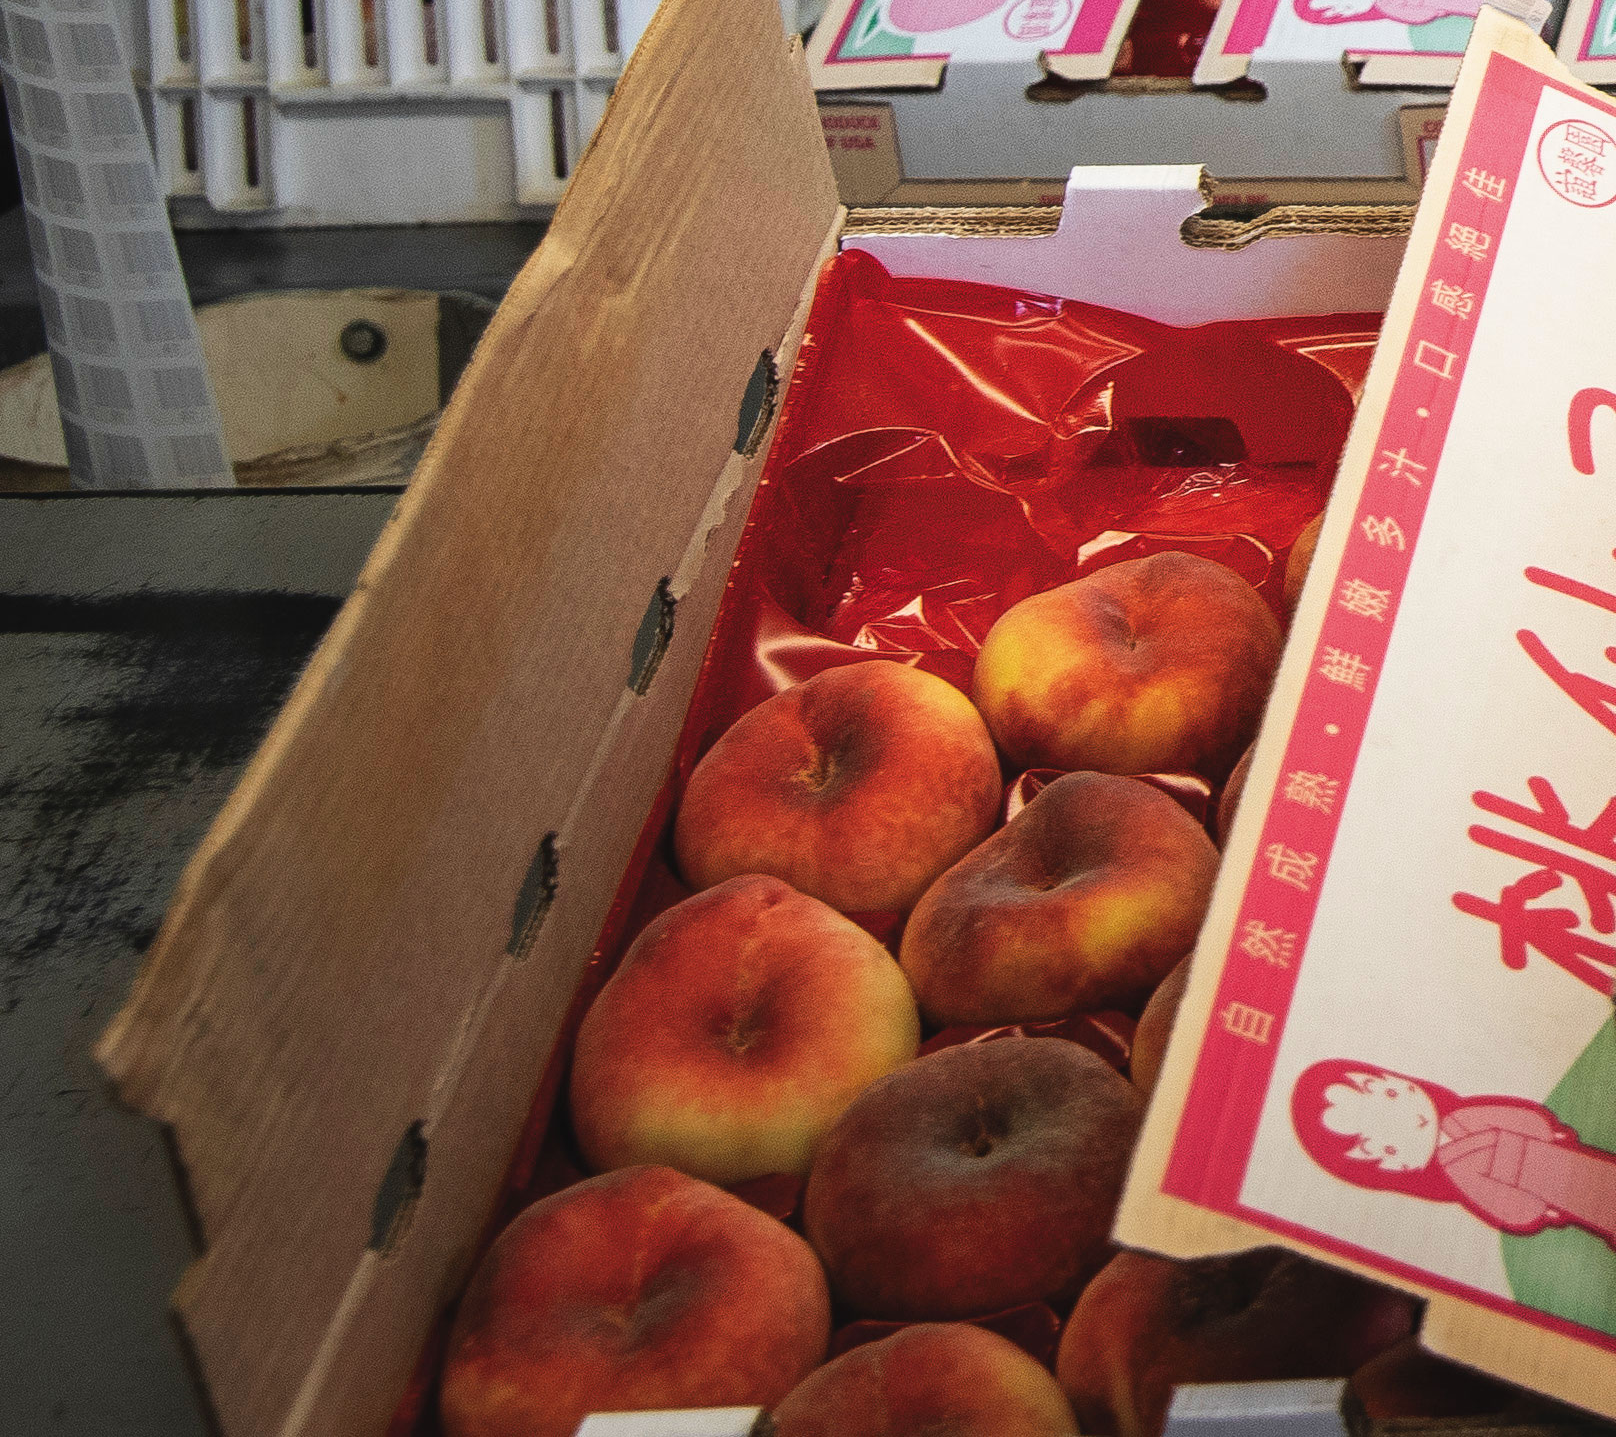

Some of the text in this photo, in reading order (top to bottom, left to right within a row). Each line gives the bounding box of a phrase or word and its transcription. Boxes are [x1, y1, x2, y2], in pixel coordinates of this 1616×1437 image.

[1219, 163, 1512, 1046] 自然成熟·鮮嫩多汁·口感絕佳
